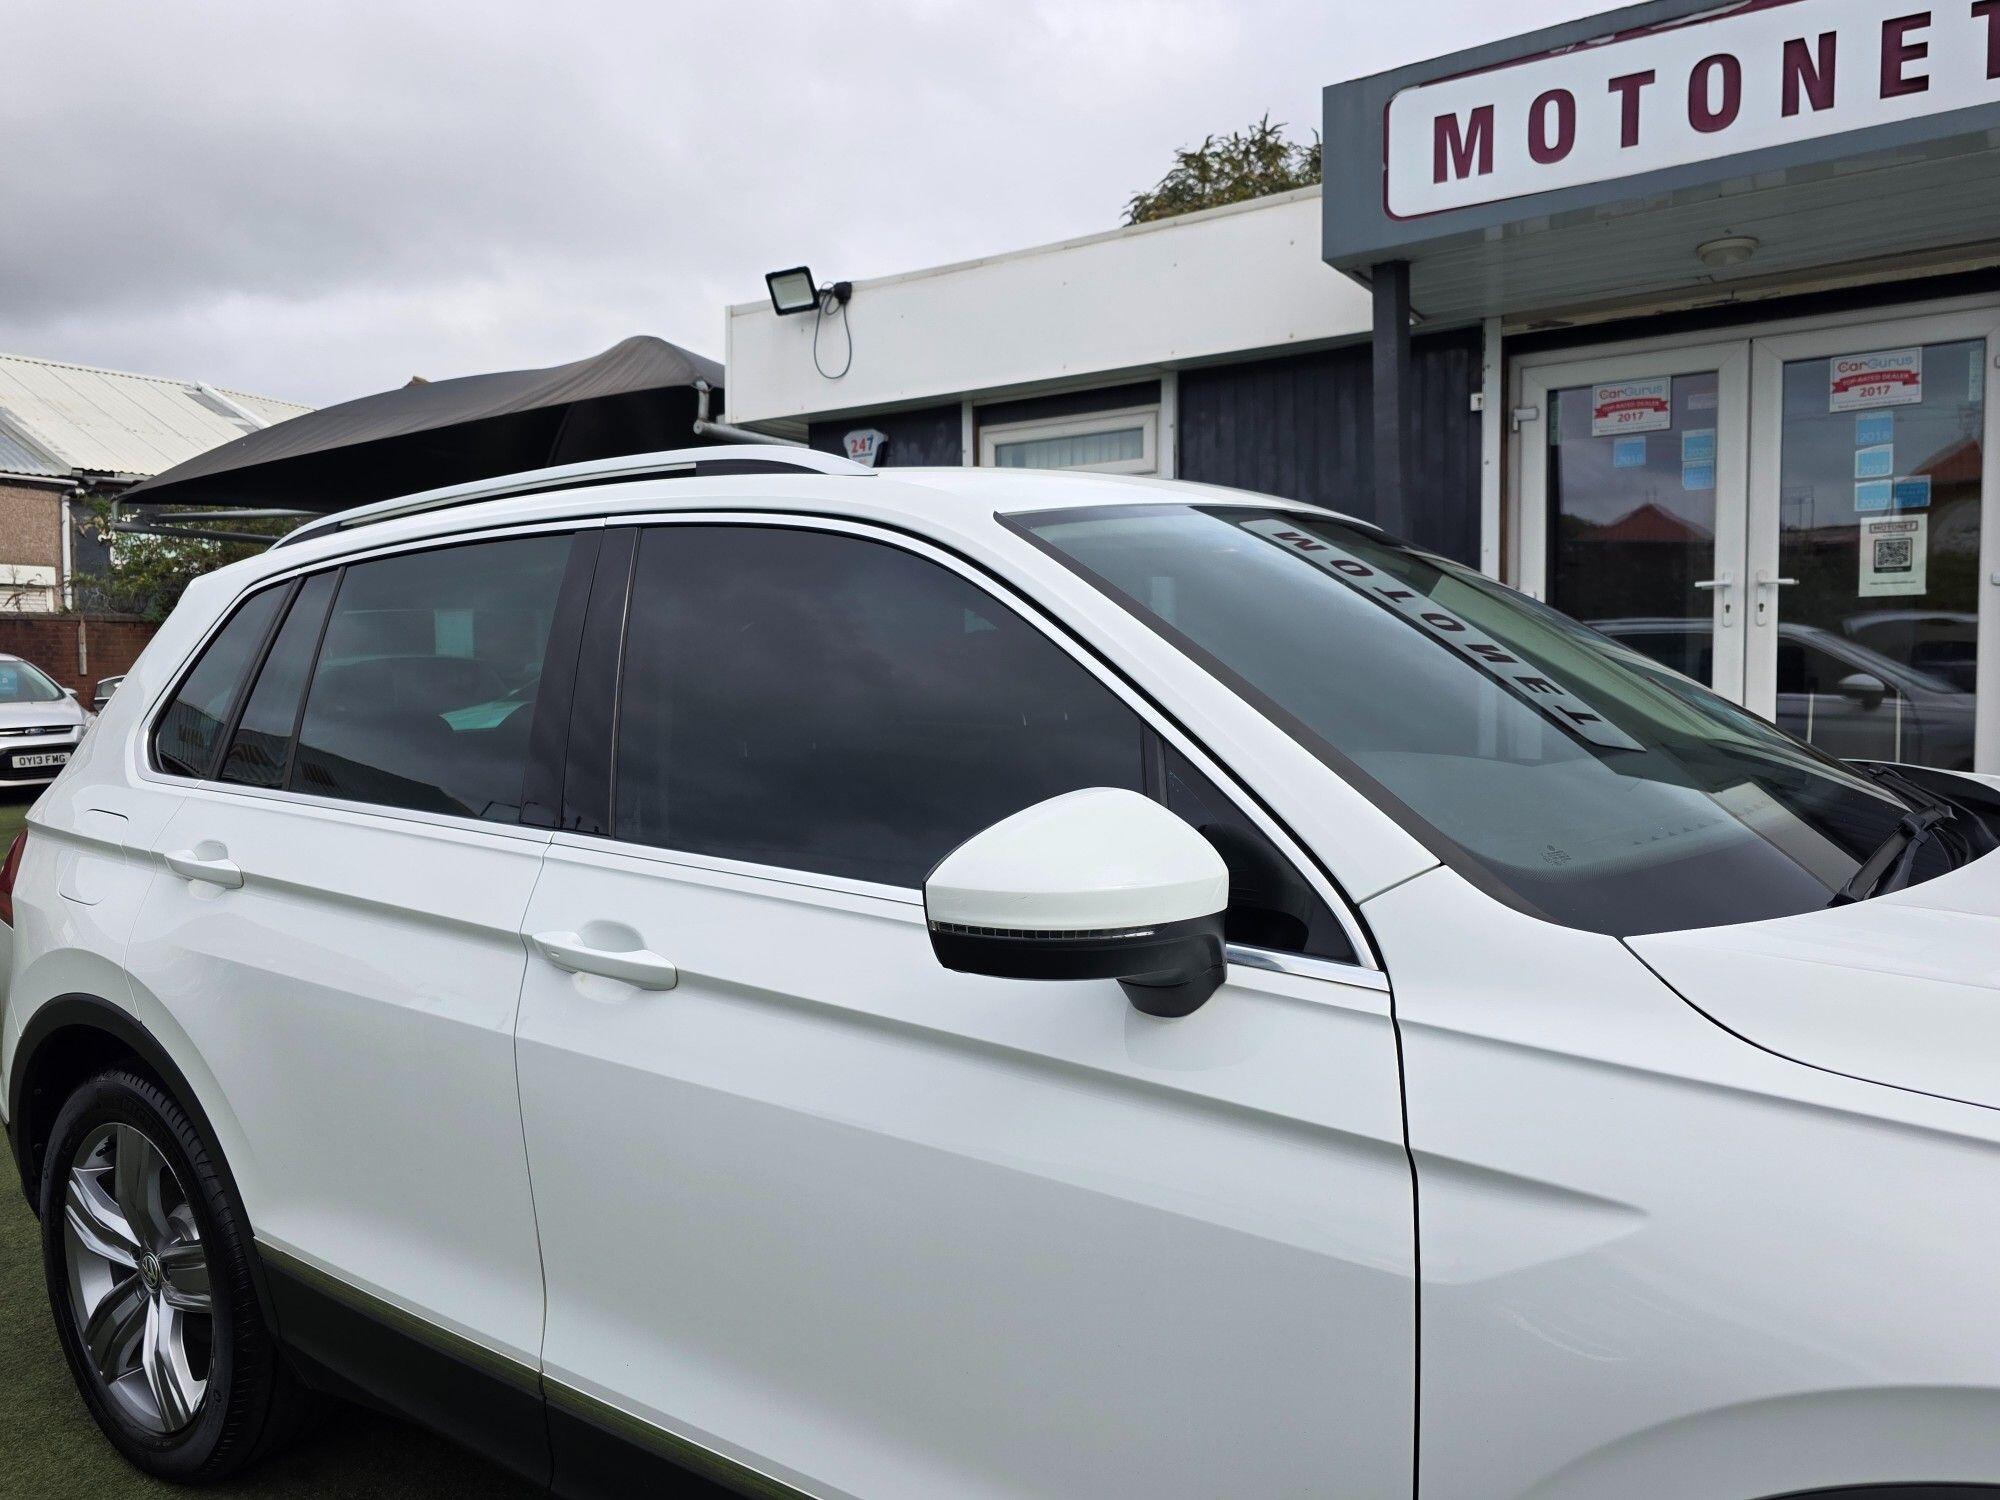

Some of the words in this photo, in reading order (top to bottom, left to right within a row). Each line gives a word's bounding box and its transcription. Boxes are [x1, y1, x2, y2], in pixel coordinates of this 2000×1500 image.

[1838, 356, 1913, 373] CarGurus
[1882, 373, 1910, 381] DEALER
[1599, 385, 1664, 400] CarGurus
[1860, 385, 1891, 397] 2017
[1617, 411, 1645, 423] 2017
[851, 434, 874, 453] 247
[19, 756, 43, 766] OY13
